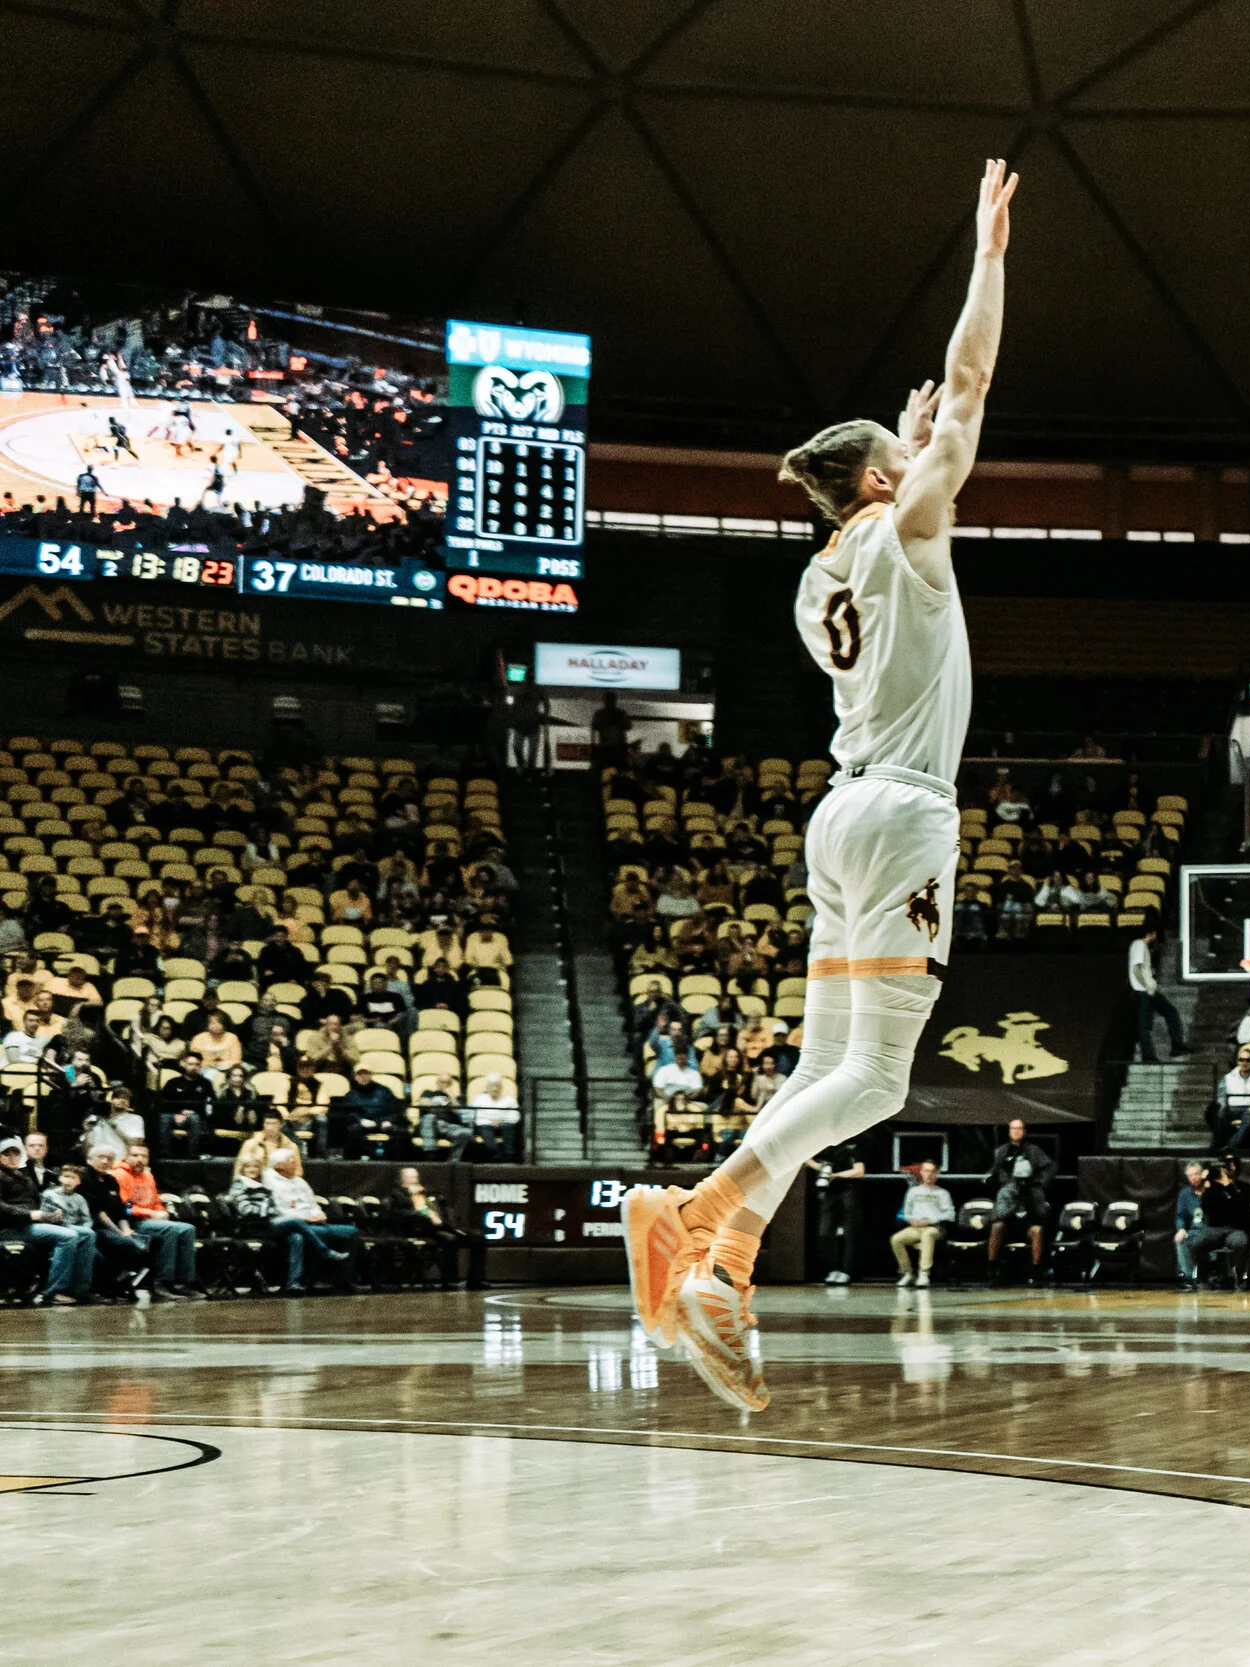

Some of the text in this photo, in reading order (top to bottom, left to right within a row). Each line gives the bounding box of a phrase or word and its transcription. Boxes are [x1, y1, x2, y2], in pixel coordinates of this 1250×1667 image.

[516, 461, 528, 477] 1
[37, 542, 84, 575] 54
[102, 561, 118, 577] 2
[131, 552, 234, 585] 13:18 23
[468, 550, 479, 567] 1
[536, 556, 581, 576] POSS
[250, 560, 297, 592] 37
[300, 563, 373, 586] COLORADO
[448, 574, 579, 604] QDOBA
[101, 602, 262, 635] WESTERN
[822, 587, 862, 671] 0
[143, 631, 354, 665] STATES BANK
[567, 657, 649, 671] HALLADAY
[475, 1183, 529, 1203] HOME
[484, 1208, 566, 1240] 54 P
[582, 1222, 623, 1237] PERIO
